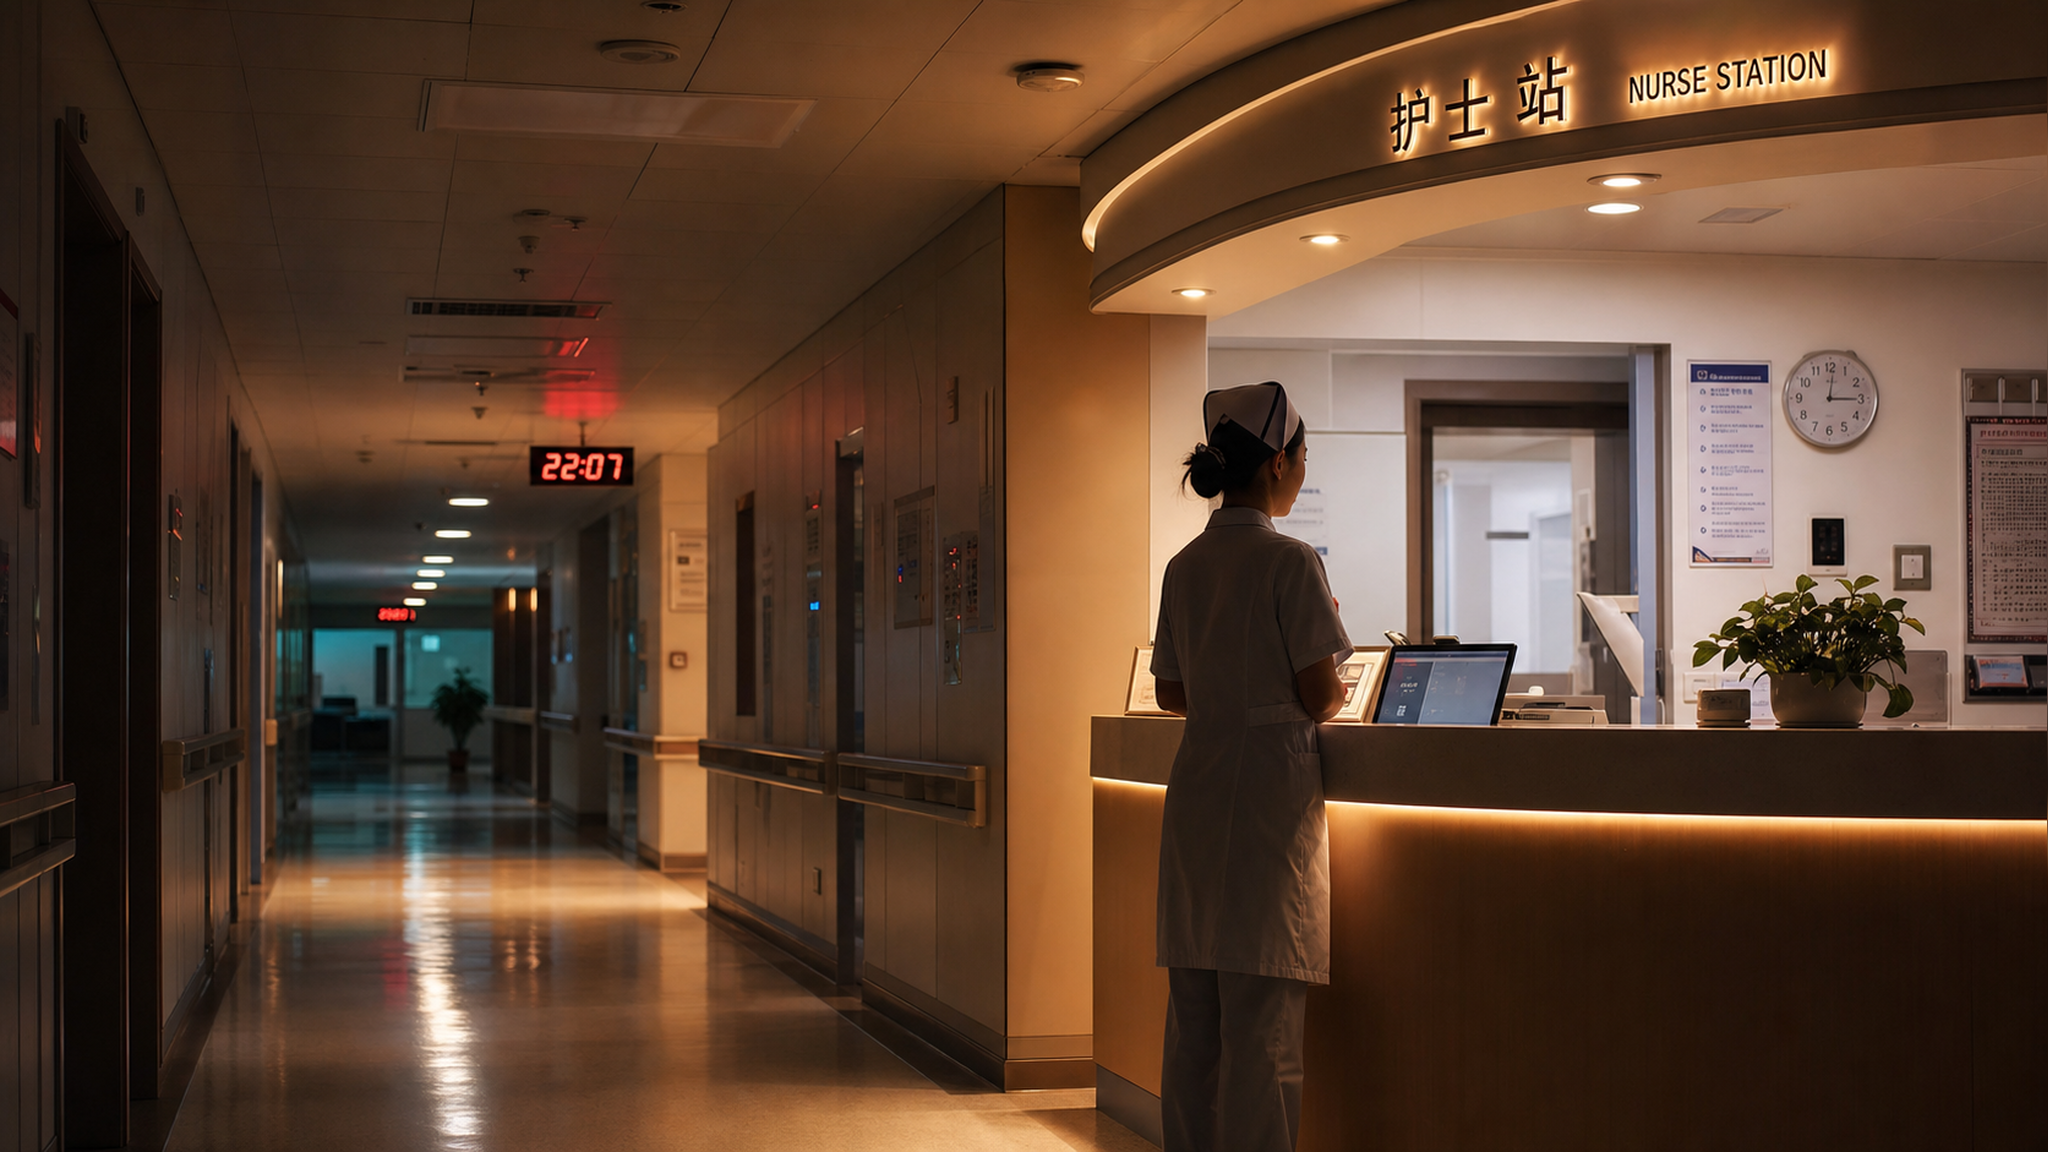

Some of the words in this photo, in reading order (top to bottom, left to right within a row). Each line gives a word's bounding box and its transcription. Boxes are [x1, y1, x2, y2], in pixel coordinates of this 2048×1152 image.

[1629, 65, 1707, 104] NURSE
[1716, 49, 1827, 91] STATION
[1390, 56, 1569, 154] 护士站
[1812, 366, 1820, 376] 11
[1825, 362, 1836, 373] 12
[1843, 366, 1847, 376] 1
[1800, 377, 1811, 388] 10
[1852, 377, 1860, 388] 2
[1795, 392, 1803, 404] 9
[1857, 393, 1865, 404] 3
[1800, 409, 1807, 420] 8
[1852, 410, 1859, 420] 4
[1812, 421, 1818, 432] 7
[1825, 425, 1833, 436] 6
[1840, 421, 1848, 432] 5
[541, 452, 624, 481] 22:07
